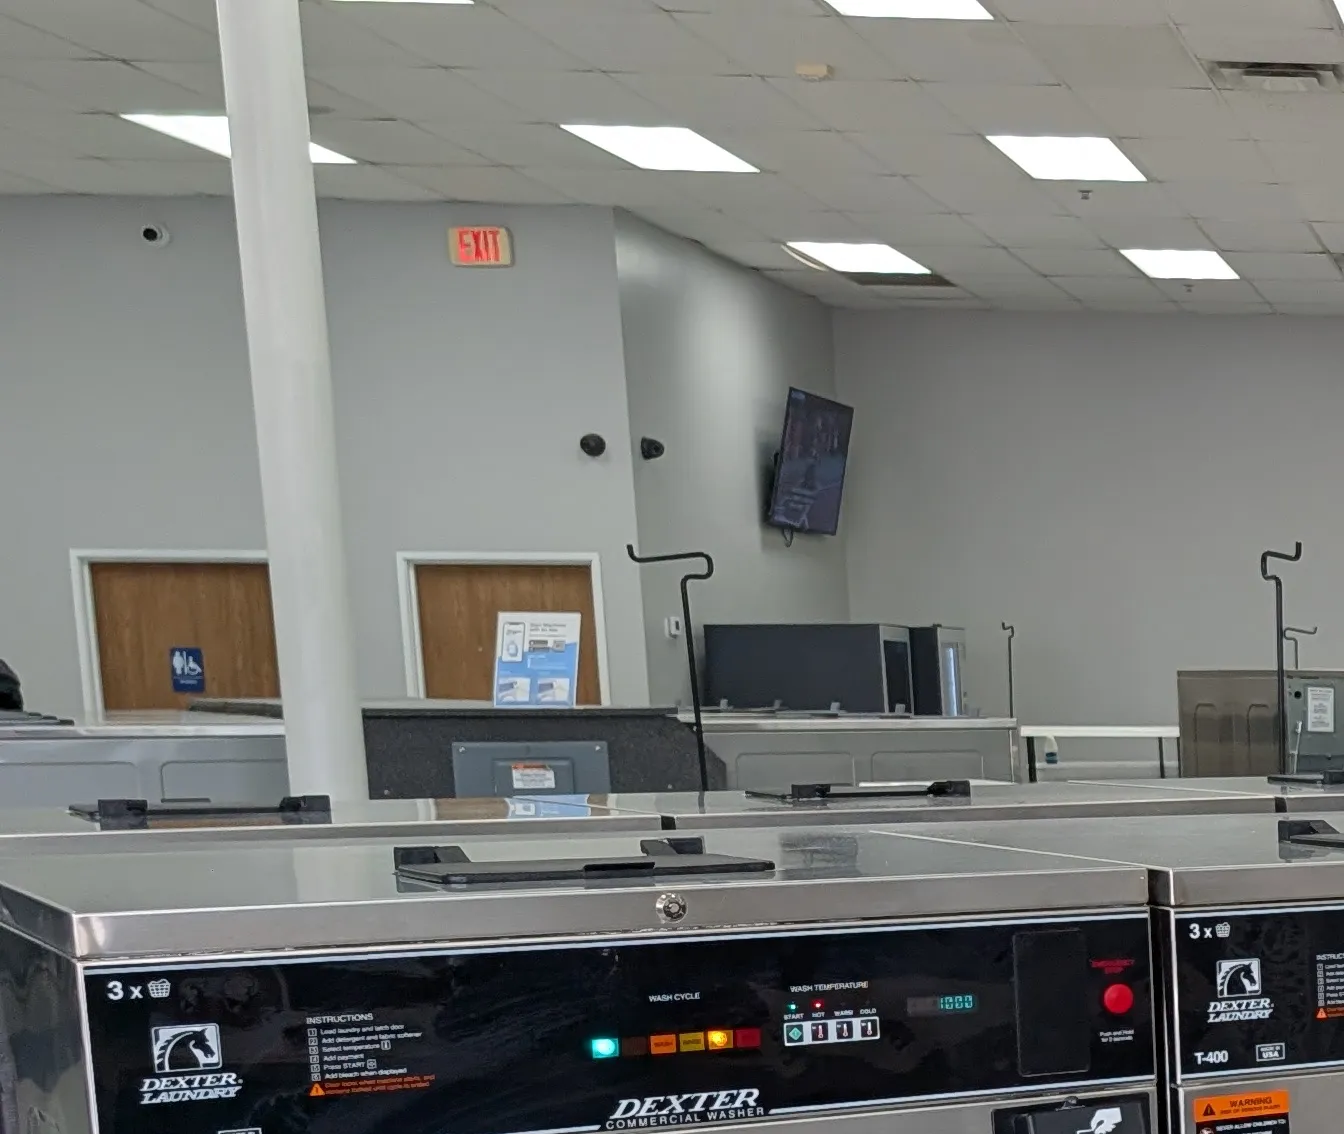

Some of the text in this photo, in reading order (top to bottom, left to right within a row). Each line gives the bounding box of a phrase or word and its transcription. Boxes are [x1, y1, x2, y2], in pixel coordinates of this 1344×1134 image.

[459, 230, 500, 262] EXIT
[1189, 923, 1212, 940] 3 x
[107, 981, 143, 1000] 3 x
[790, 981, 868, 993] WASH TEMPERATURE
[649, 992, 700, 1003] WASH CYCLE
[1207, 998, 1271, 1012] DEXTER
[306, 1013, 373, 1024] INSTRUCTIONS
[1207, 1009, 1273, 1023] LAUNDRY
[1194, 1051, 1228, 1065] T-400
[140, 1073, 238, 1091] DEXTER
[140, 1086, 242, 1104] LAUNDRY
[1229, 1097, 1272, 1108] WARNING
[610, 1088, 760, 1120] DEXTER
[606, 1107, 764, 1131] COMMERCIAL WASHER
